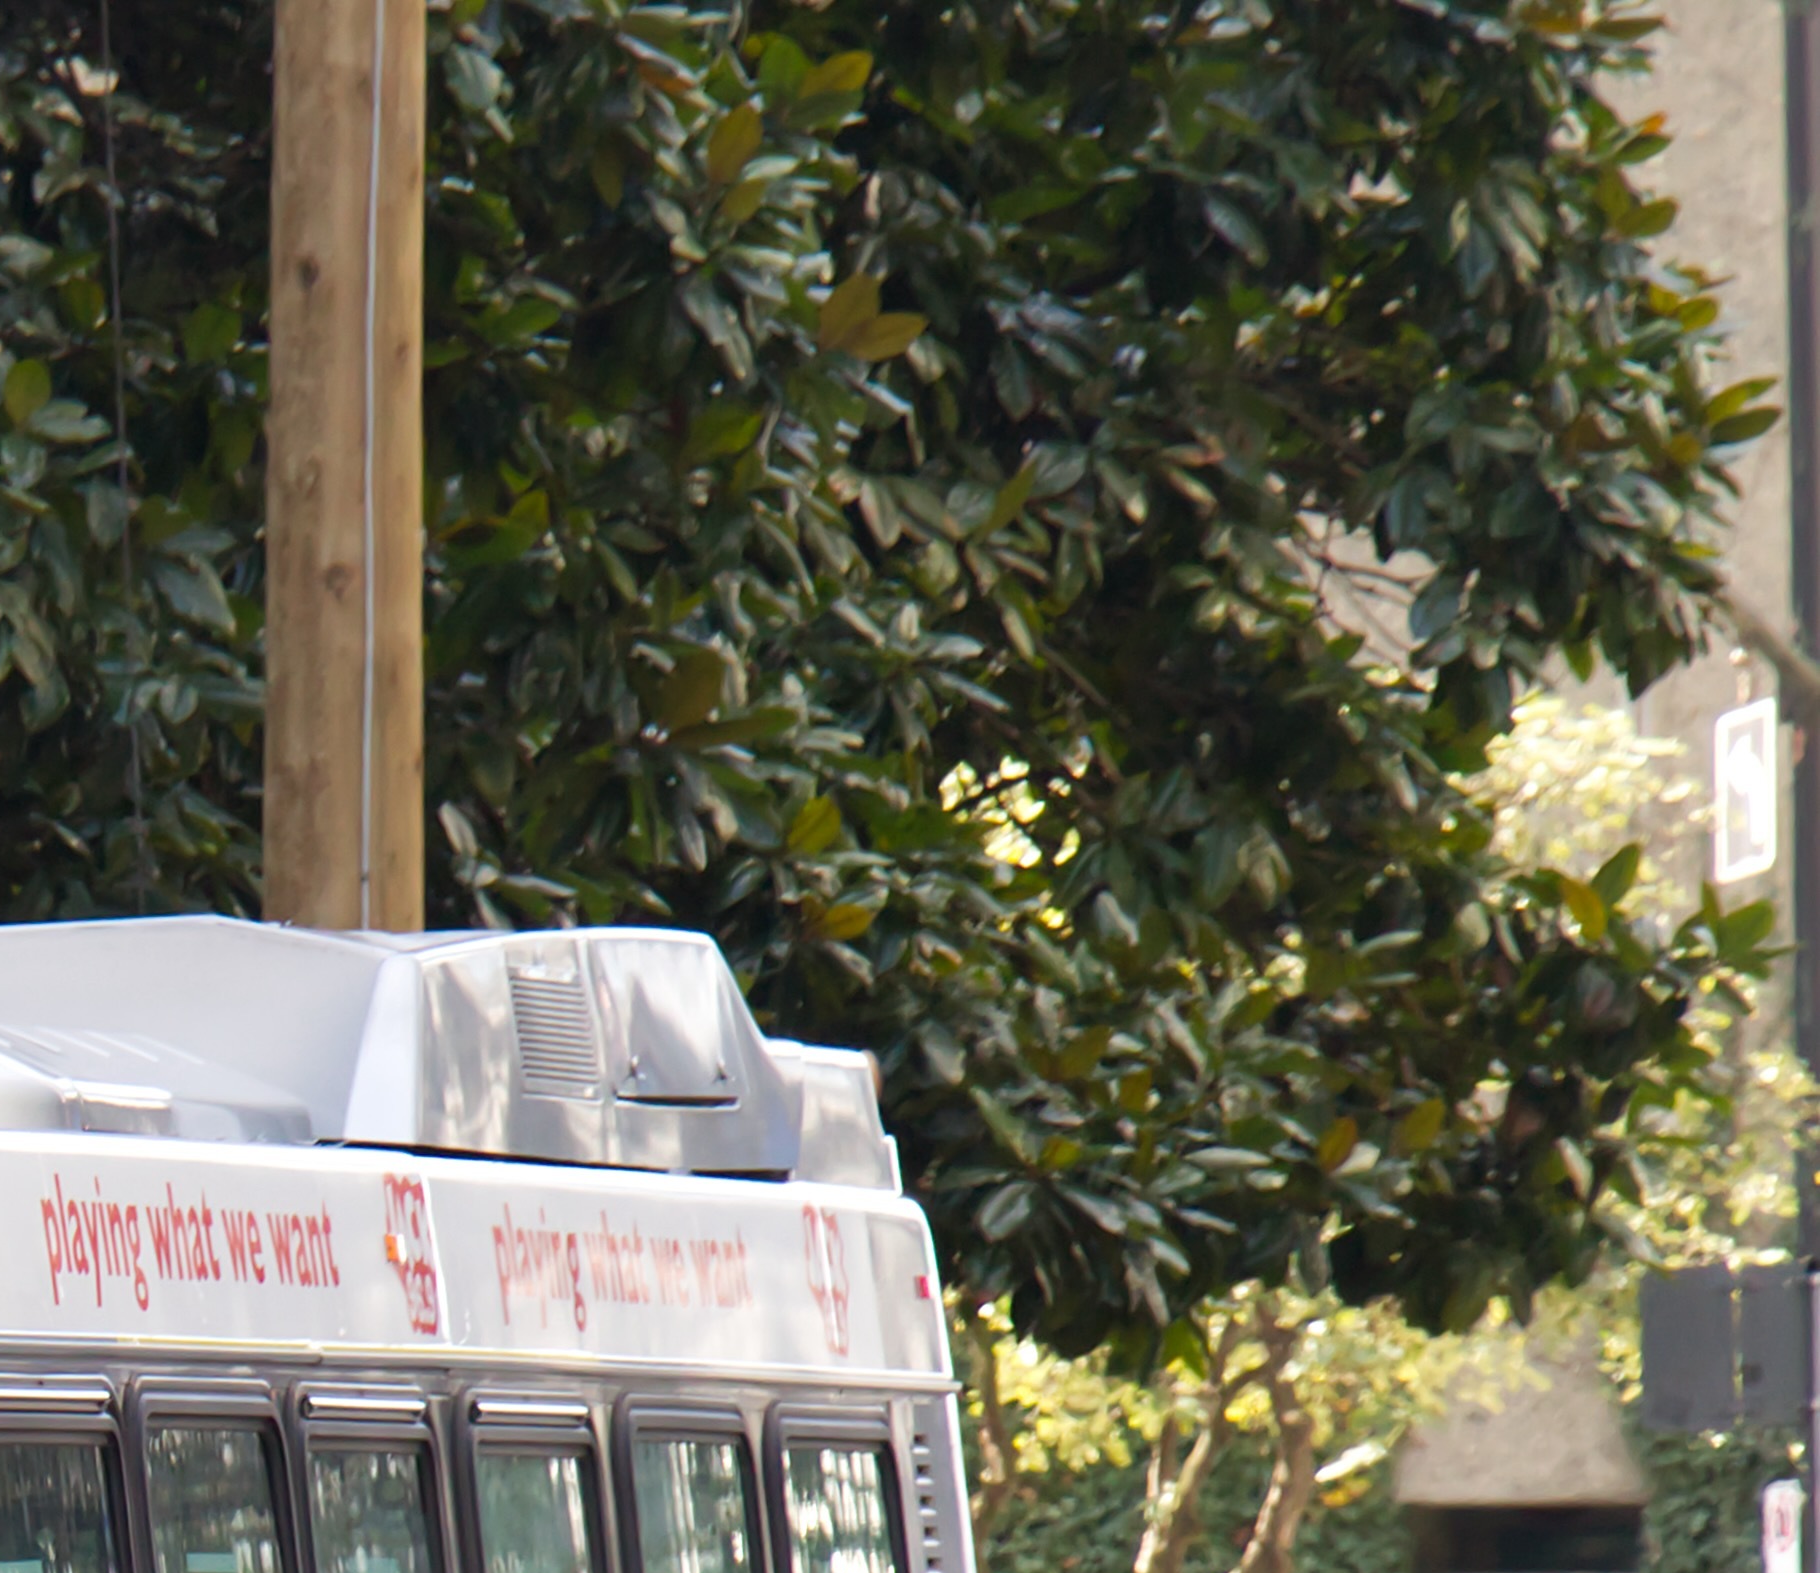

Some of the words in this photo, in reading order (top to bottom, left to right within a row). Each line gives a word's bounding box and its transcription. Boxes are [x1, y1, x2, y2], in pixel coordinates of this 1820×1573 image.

[40, 1173, 149, 1311] playing
[146, 1181, 221, 1282] what
[221, 1207, 266, 1285] we
[266, 1200, 340, 1288] want
[491, 1202, 587, 1332] playing
[583, 1209, 650, 1304] what
